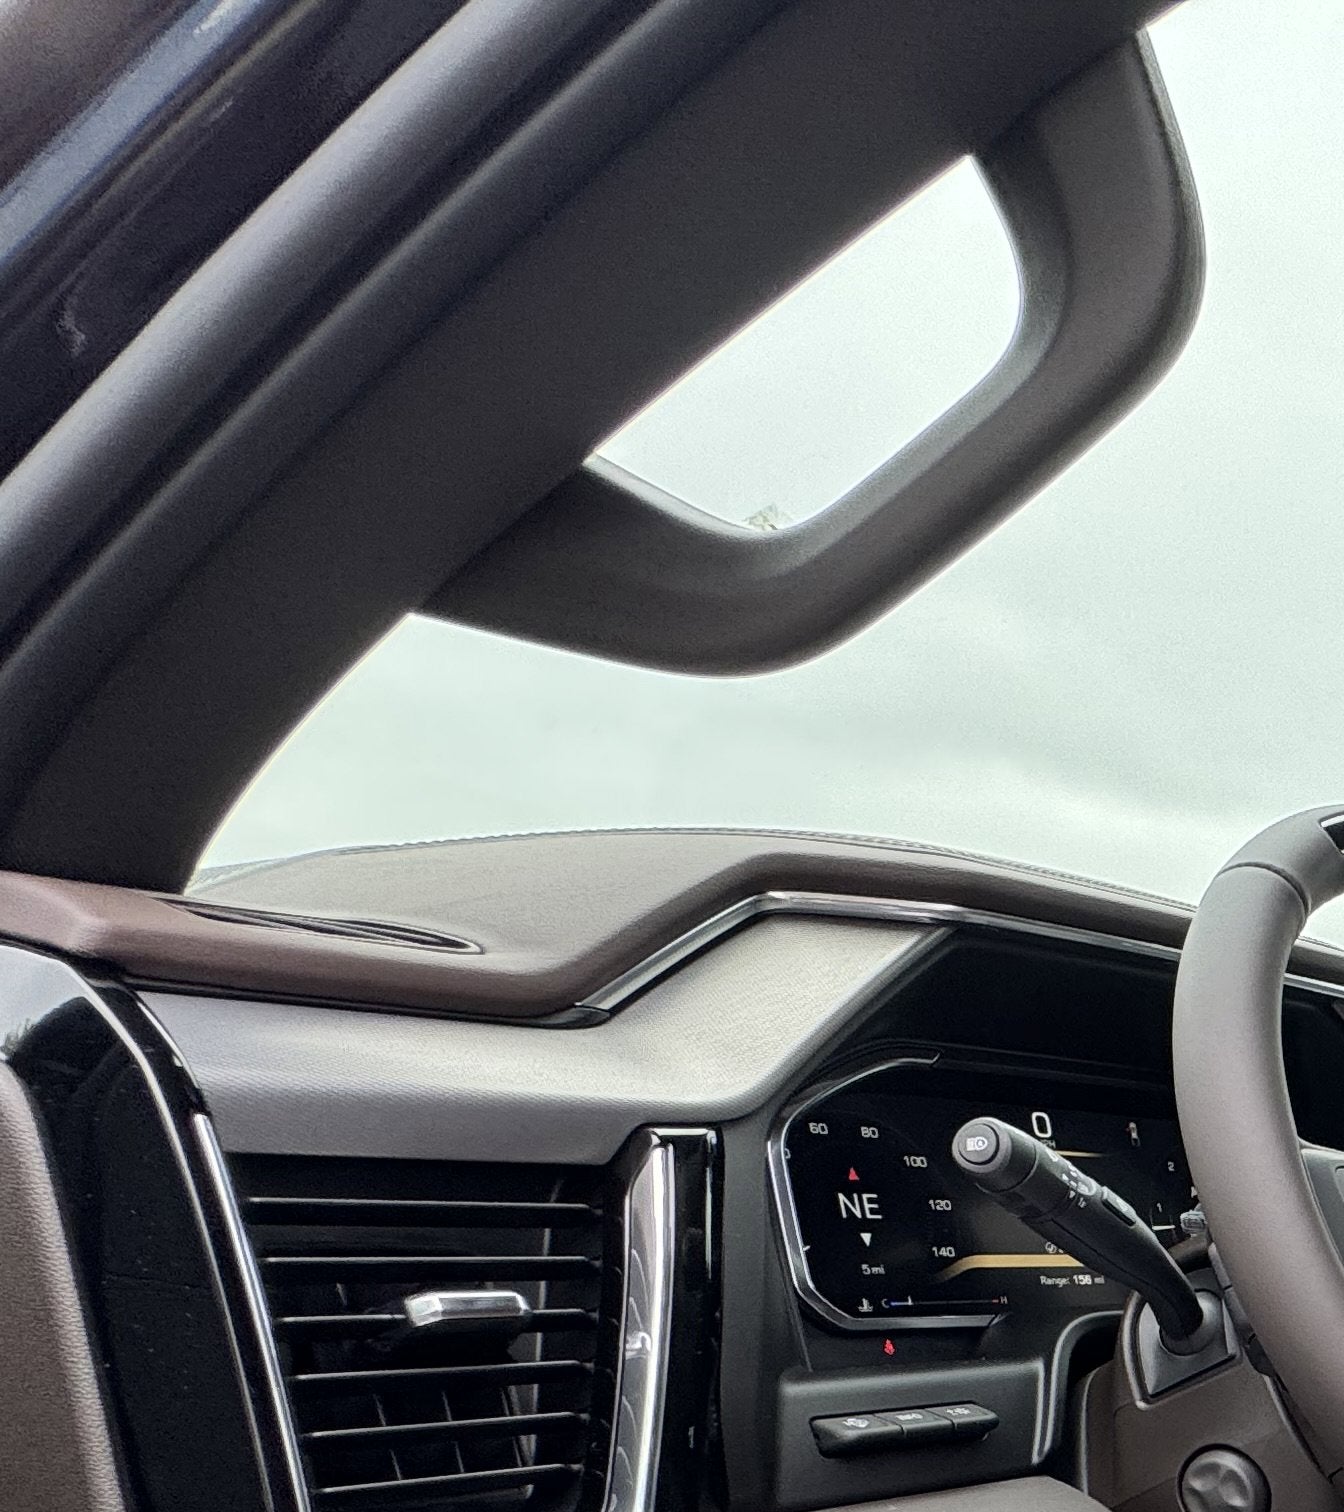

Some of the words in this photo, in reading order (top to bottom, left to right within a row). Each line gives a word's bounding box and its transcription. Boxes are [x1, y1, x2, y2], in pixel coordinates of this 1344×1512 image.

[808, 1122, 829, 1135] 60
[1031, 1111, 1052, 1138] 0
[860, 1126, 879, 1138] 80
[903, 1155, 928, 1168] 100
[838, 1193, 883, 1220] NE
[928, 1199, 952, 1211] 120
[932, 1246, 955, 1258] 140
[861, 1264, 871, 1275] 5
